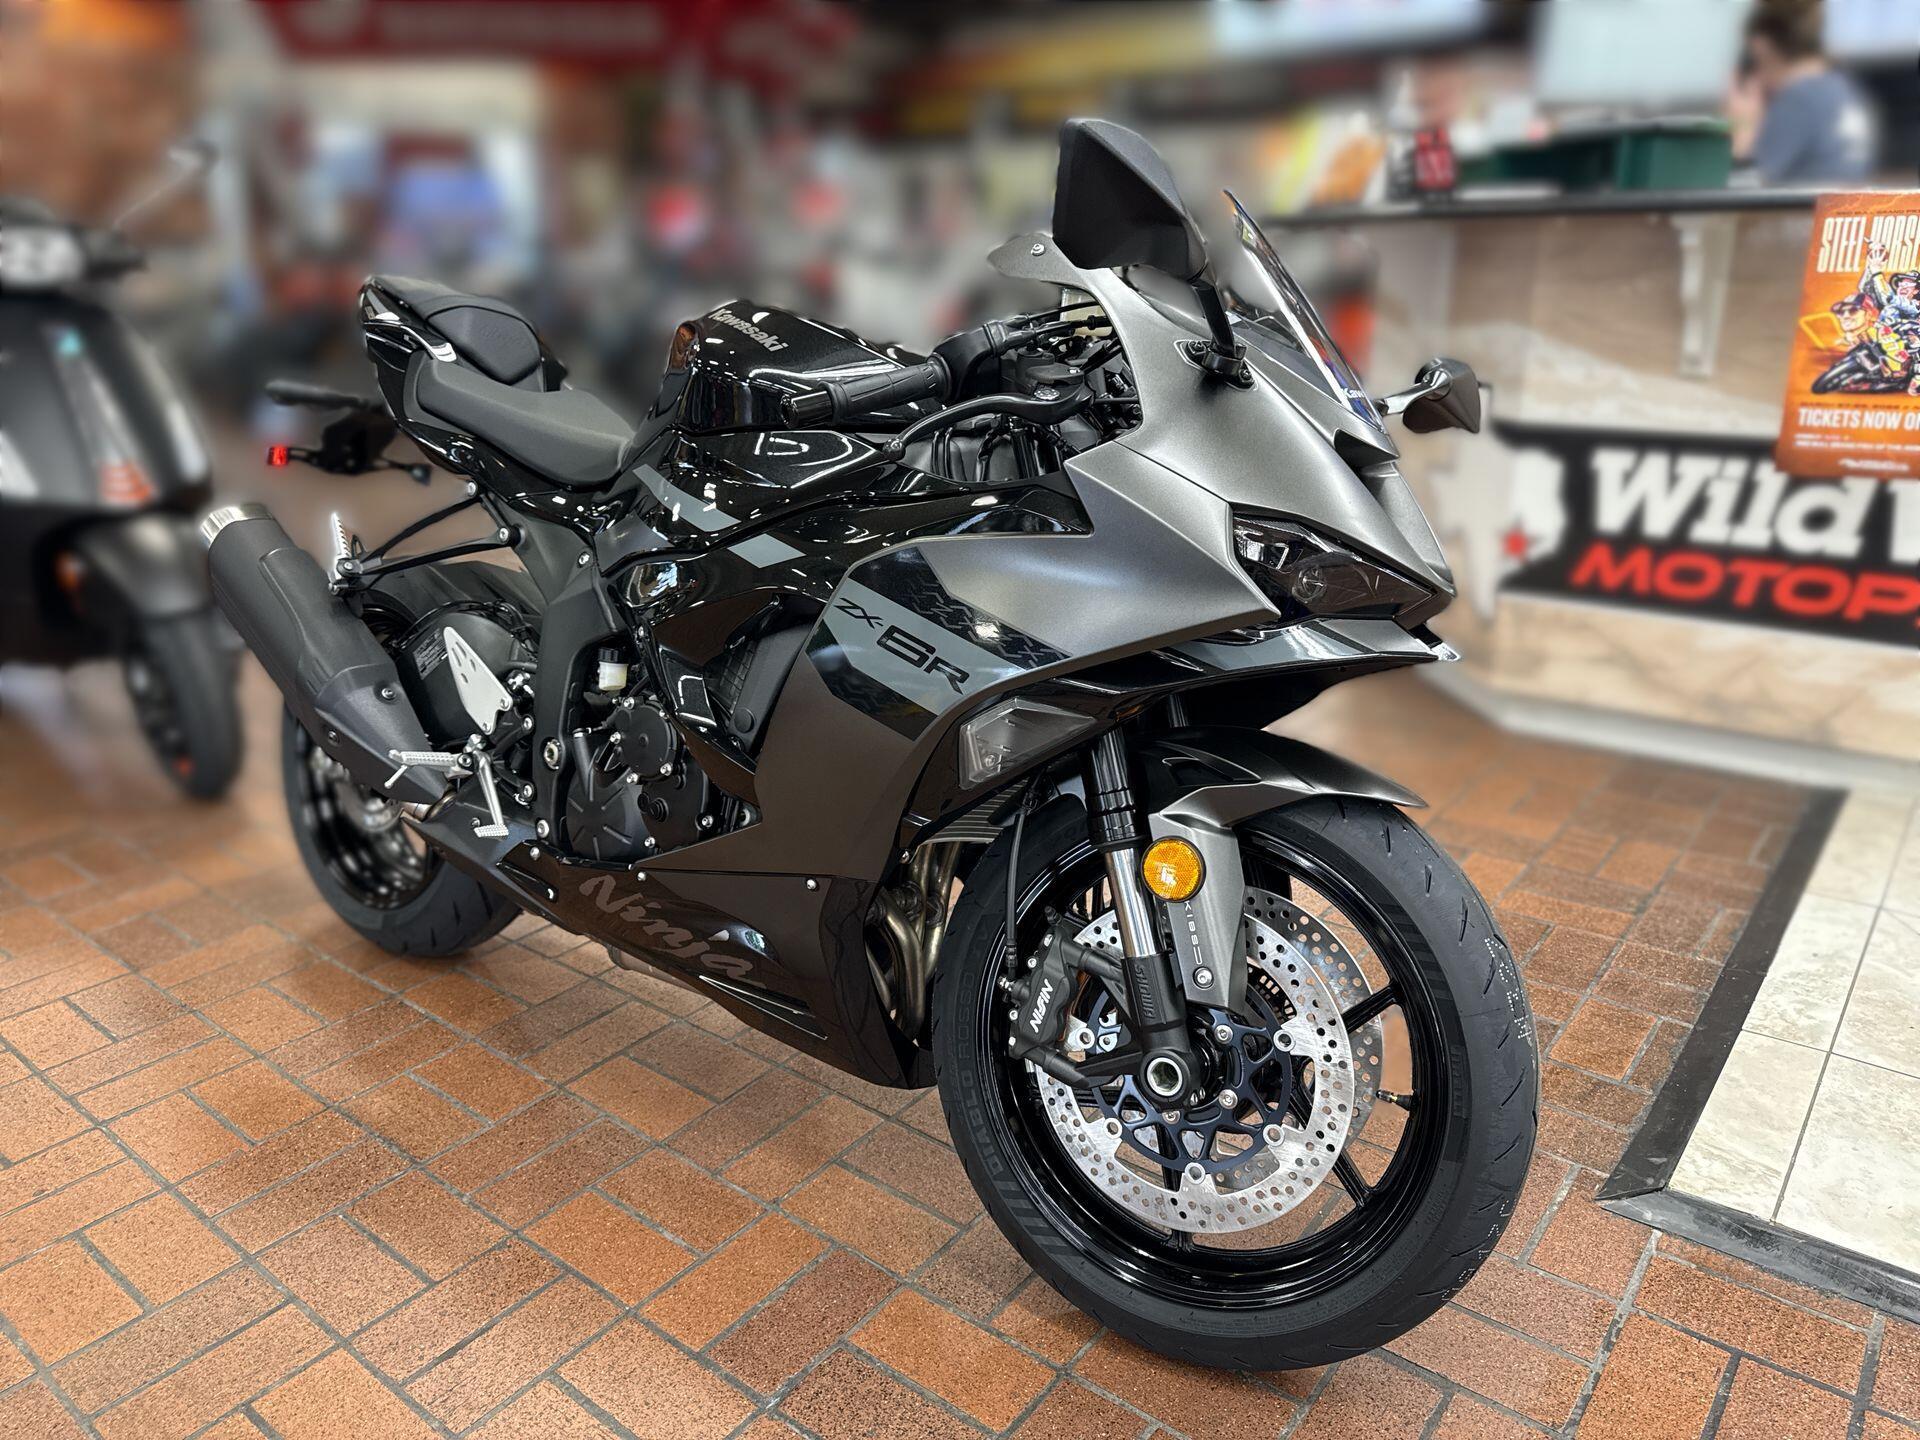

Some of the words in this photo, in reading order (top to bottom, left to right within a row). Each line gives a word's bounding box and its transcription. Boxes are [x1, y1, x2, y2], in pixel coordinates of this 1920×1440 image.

[1816, 216, 1867, 273] STEEL
[708, 309, 790, 352] Kawasaki
[1798, 407, 1861, 429] TICKETS
[1862, 410, 1902, 431] NOW
[1592, 450, 1879, 559] Wild
[1571, 540, 1920, 631] MOTOP
[579, 874, 767, 989] Ninja
[957, 970, 977, 1062] ROSSO
[1029, 978, 1056, 1034] NISSIN
[961, 1068, 1005, 1177] DIABLO
